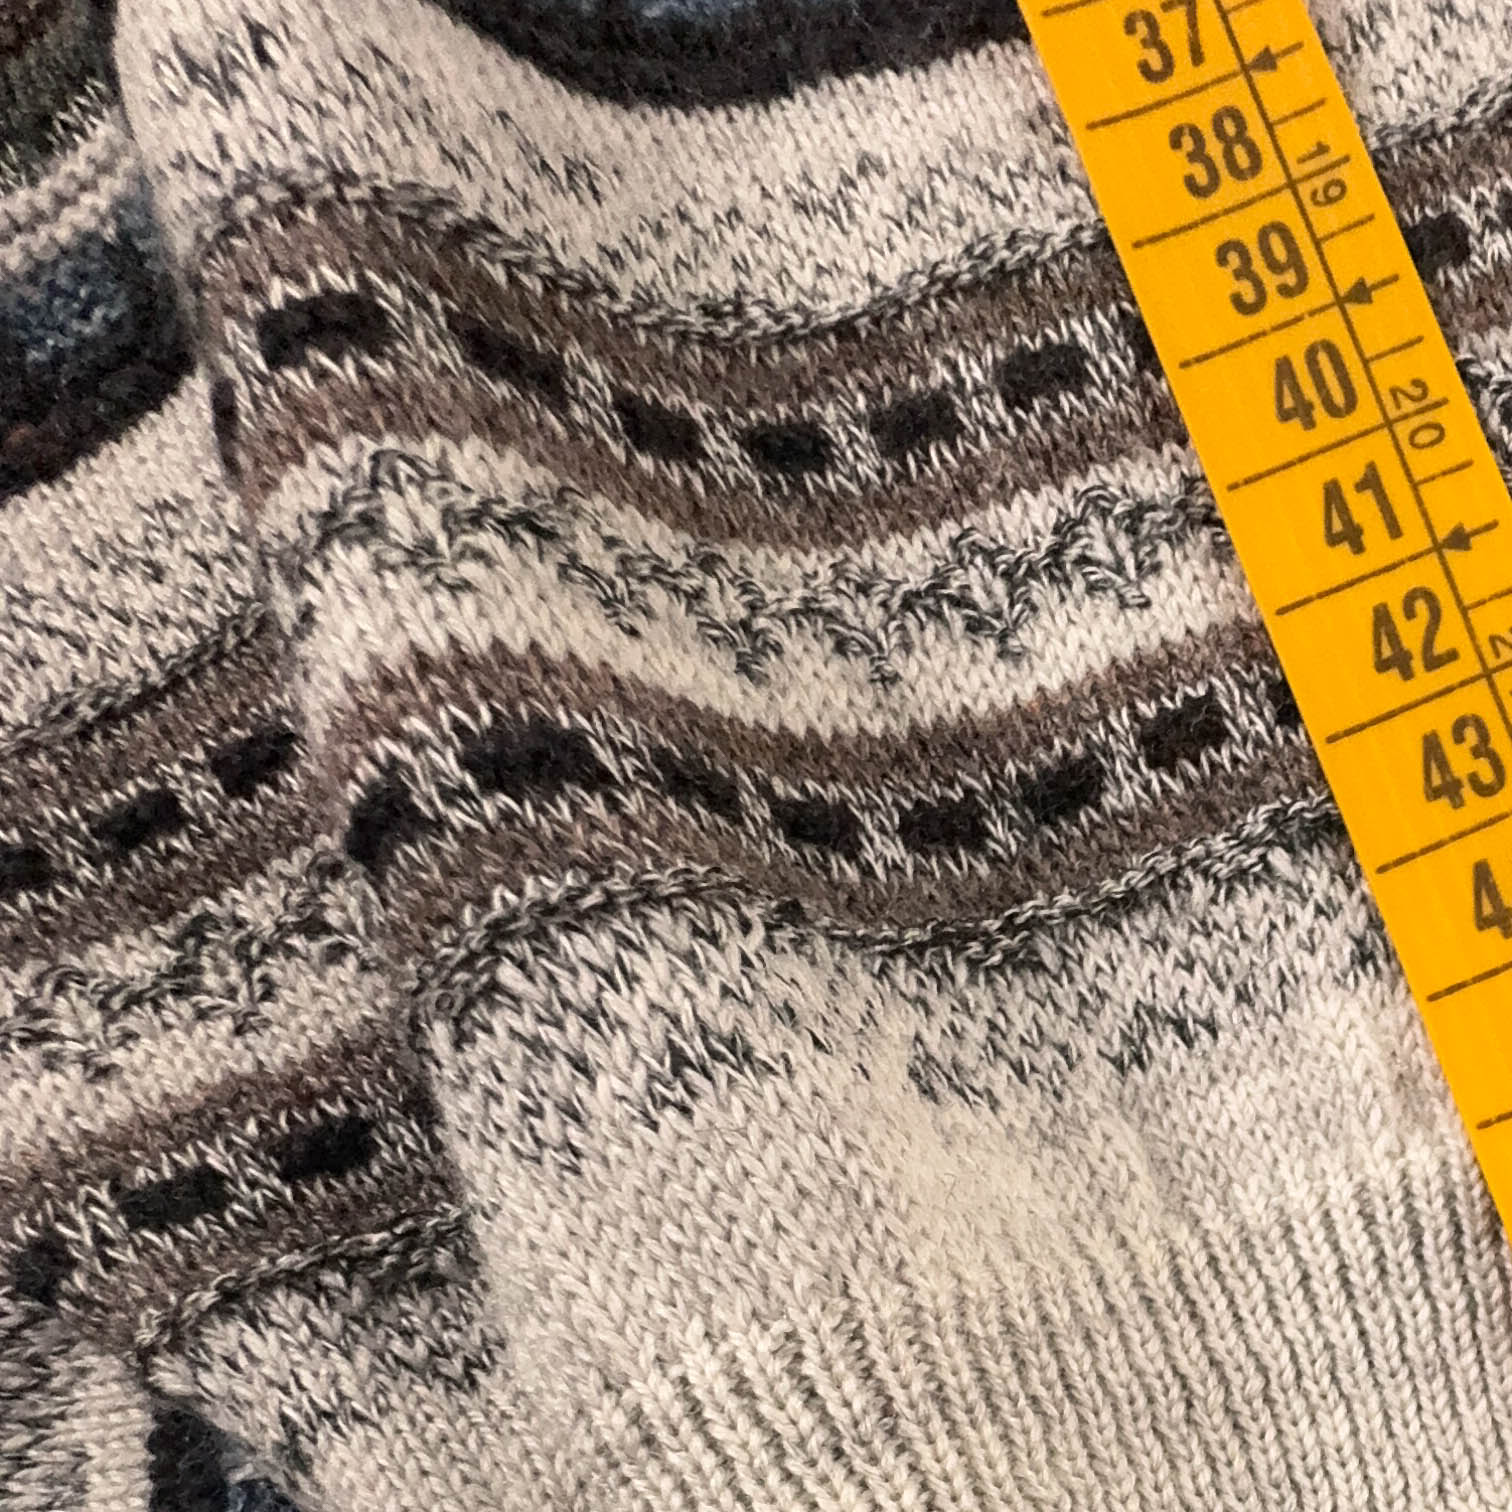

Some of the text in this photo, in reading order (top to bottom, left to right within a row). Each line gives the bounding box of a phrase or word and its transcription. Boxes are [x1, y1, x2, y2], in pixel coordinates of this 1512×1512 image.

[1123, 0, 1206, 84] 37
[1169, 105, 1263, 200] 38
[1215, 221, 1310, 317] 39
[1274, 339, 1359, 431] 40
[1323, 460, 1404, 556] 41
[1371, 586, 1459, 681] 42
[1421, 713, 1507, 810] 43
